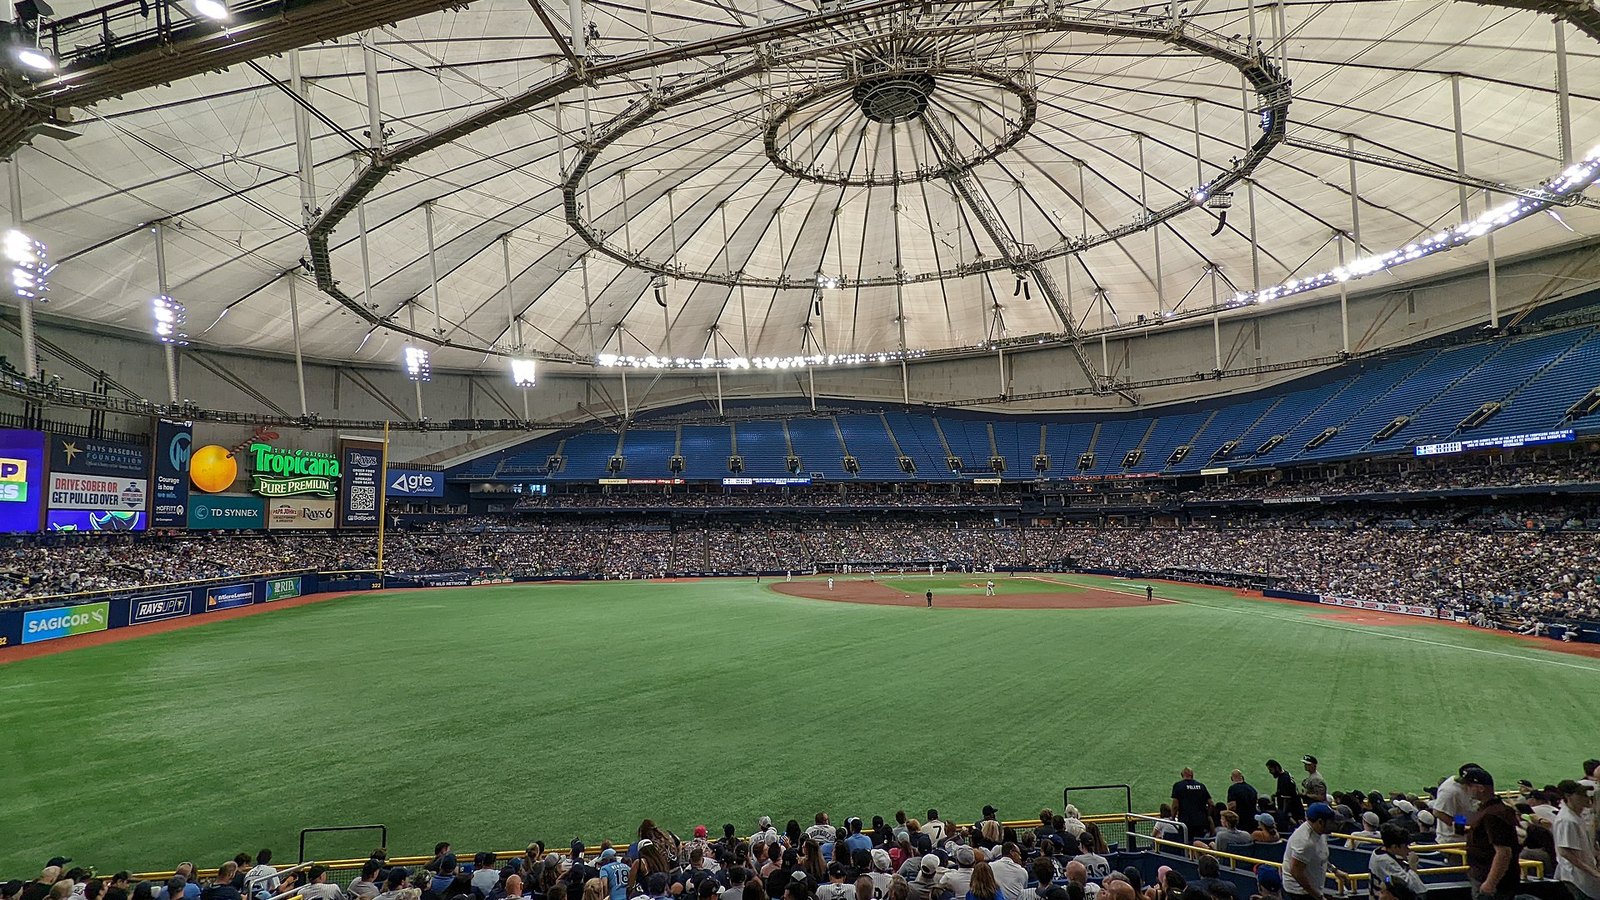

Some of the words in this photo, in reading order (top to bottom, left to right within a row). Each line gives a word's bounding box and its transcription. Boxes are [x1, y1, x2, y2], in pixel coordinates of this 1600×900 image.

[86, 444, 106, 453] RAYS
[108, 446, 142, 457] BASEBALL
[86, 452, 142, 464] FOUNDATION
[250, 444, 339, 477] Tropicana
[55, 478, 80, 491] DRIVE
[80, 480, 106, 492] SOBER
[107, 482, 118, 493] OR
[158, 475, 180, 485] Courage
[260, 481, 287, 493] PURE
[288, 480, 329, 492] PREMIUM
[408, 473, 433, 489] gte
[52, 491, 69, 503] GET
[69, 492, 99, 505] PULLED
[100, 494, 119, 506] OVER
[211, 508, 223, 517] TD
[224, 508, 258, 517] SYNNEX
[325, 508, 333, 519] 6
[28, 613, 89, 633] SAGICOR
[932, 825, 942, 840] 7
[614, 868, 629, 886] 18
